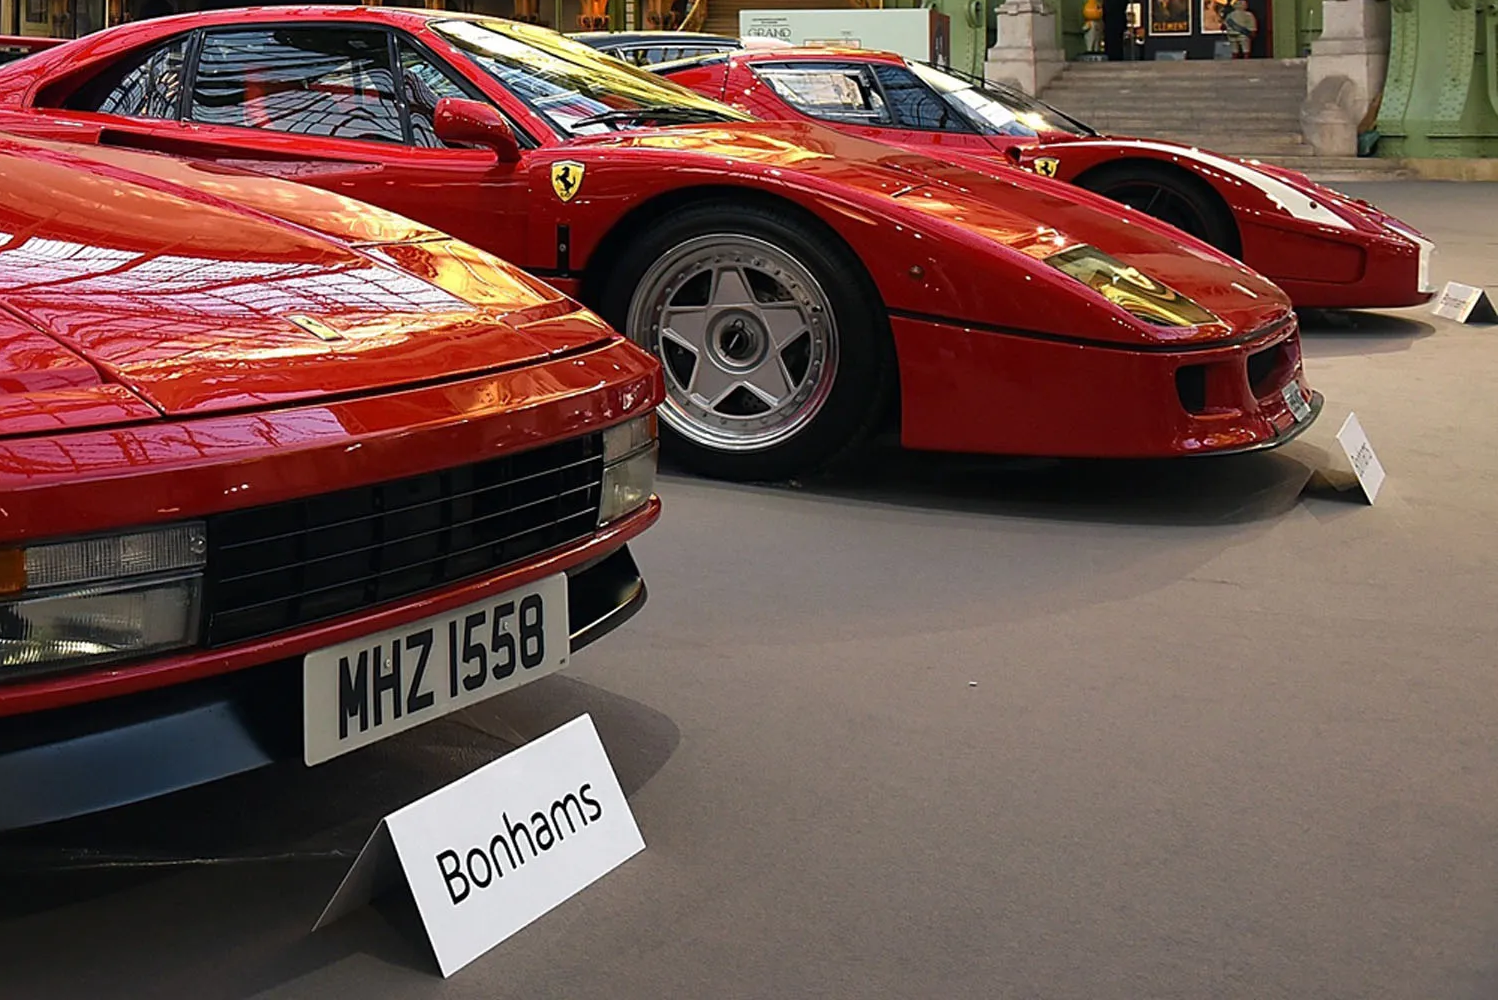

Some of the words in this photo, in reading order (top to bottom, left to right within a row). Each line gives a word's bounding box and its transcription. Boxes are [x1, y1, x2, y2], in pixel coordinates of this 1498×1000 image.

[748, 28, 791, 37] GRAND
[338, 629, 434, 740] MHZ
[449, 593, 544, 698] 1558
[436, 783, 602, 905] Bonhams
